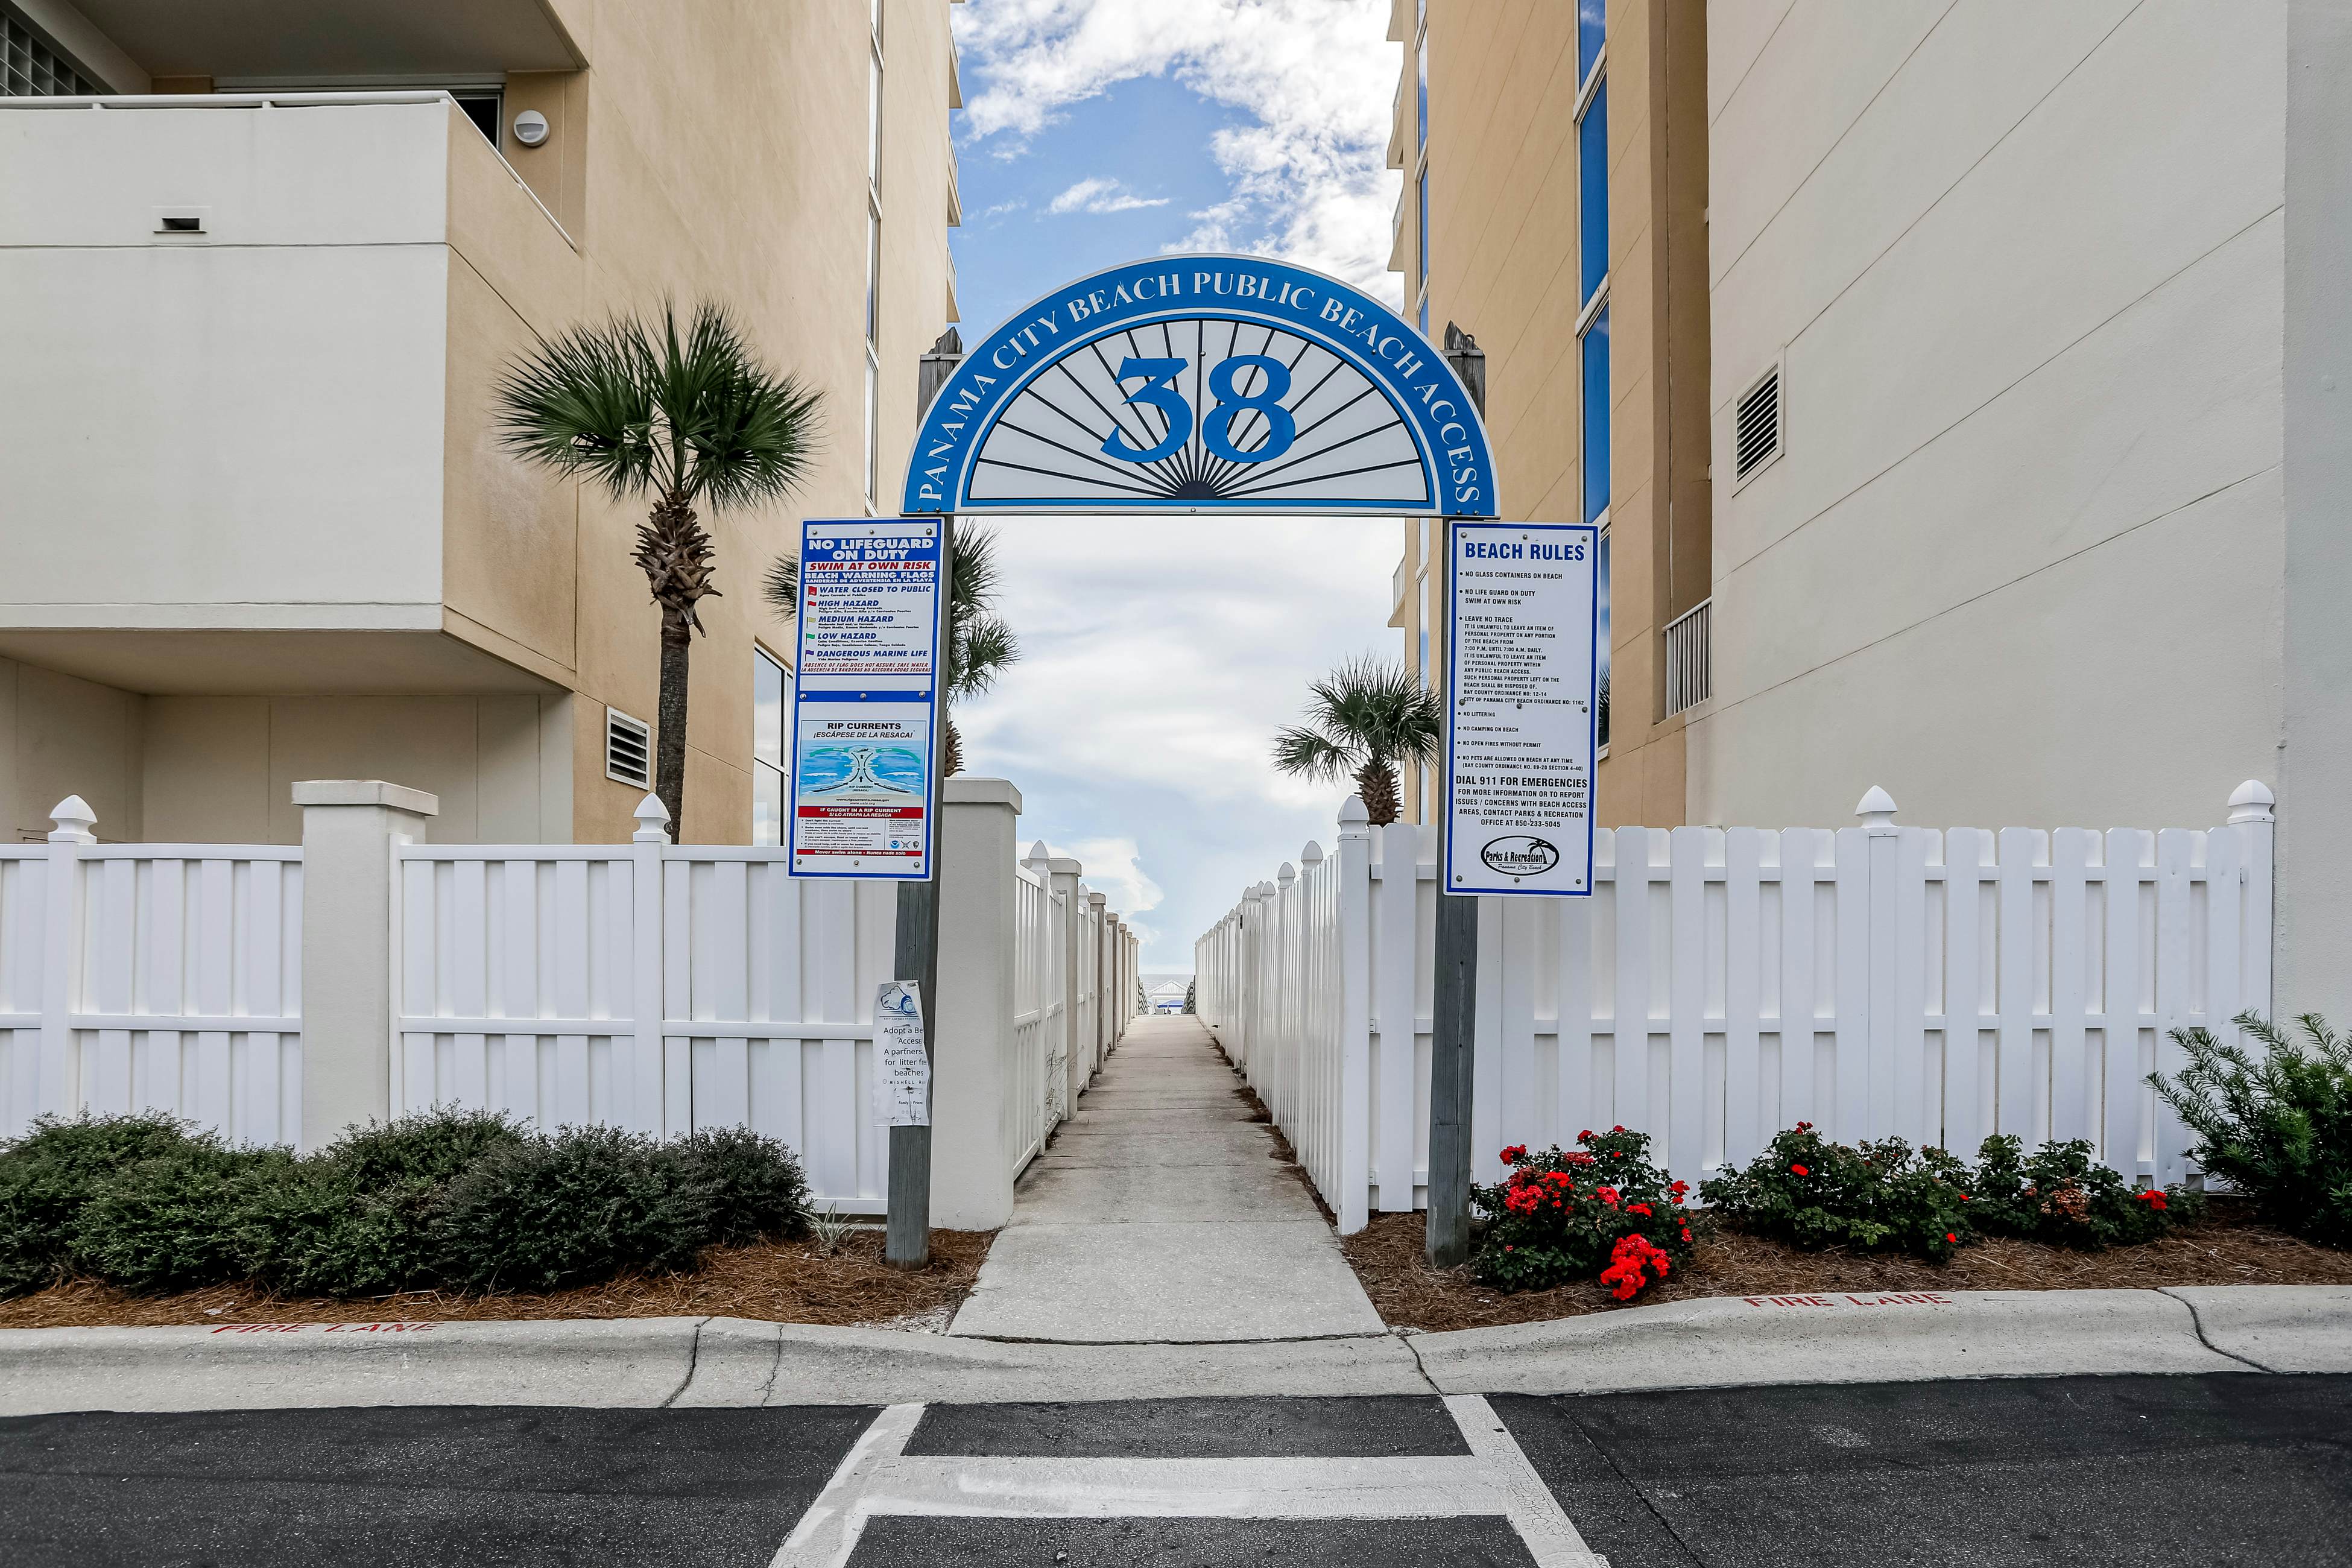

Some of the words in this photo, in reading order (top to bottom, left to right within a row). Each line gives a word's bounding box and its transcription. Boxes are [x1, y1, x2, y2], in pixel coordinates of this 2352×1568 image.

[918, 374, 997, 501] PANAMA
[993, 310, 1059, 369] CITY
[1067, 273, 1181, 323] BEACH
[1193, 272, 1315, 310] PUBLIC
[1319, 297, 1424, 379] BEACH
[1414, 384, 1479, 502] ACCESS
[1100, 355, 1296, 463] 38
[809, 540, 834, 549] NO
[841, 539, 934, 549] LIFEGUARD
[832, 550, 858, 560] ON
[864, 549, 909, 560] DUTY
[1465, 542, 1522, 559] BEACH
[1530, 544, 1584, 561] RULES
[813, 730, 856, 739] ¡ESCÁPESE
[1456, 775, 1476, 785] DIAL
[1479, 776, 1496, 785] 911
[1500, 777, 1518, 786] FOR
[1522, 777, 1587, 788] EMERGENCIES
[1485, 851, 1503, 861] Parks
[1503, 852, 1508, 862] &
[1510, 852, 1543, 862] Recreation
[1742, 1295, 1835, 1307] FIRE
[1844, 1294, 1952, 1306] LANE
[211, 1324, 315, 1333] FIRE
[324, 1323, 445, 1332] LANE
